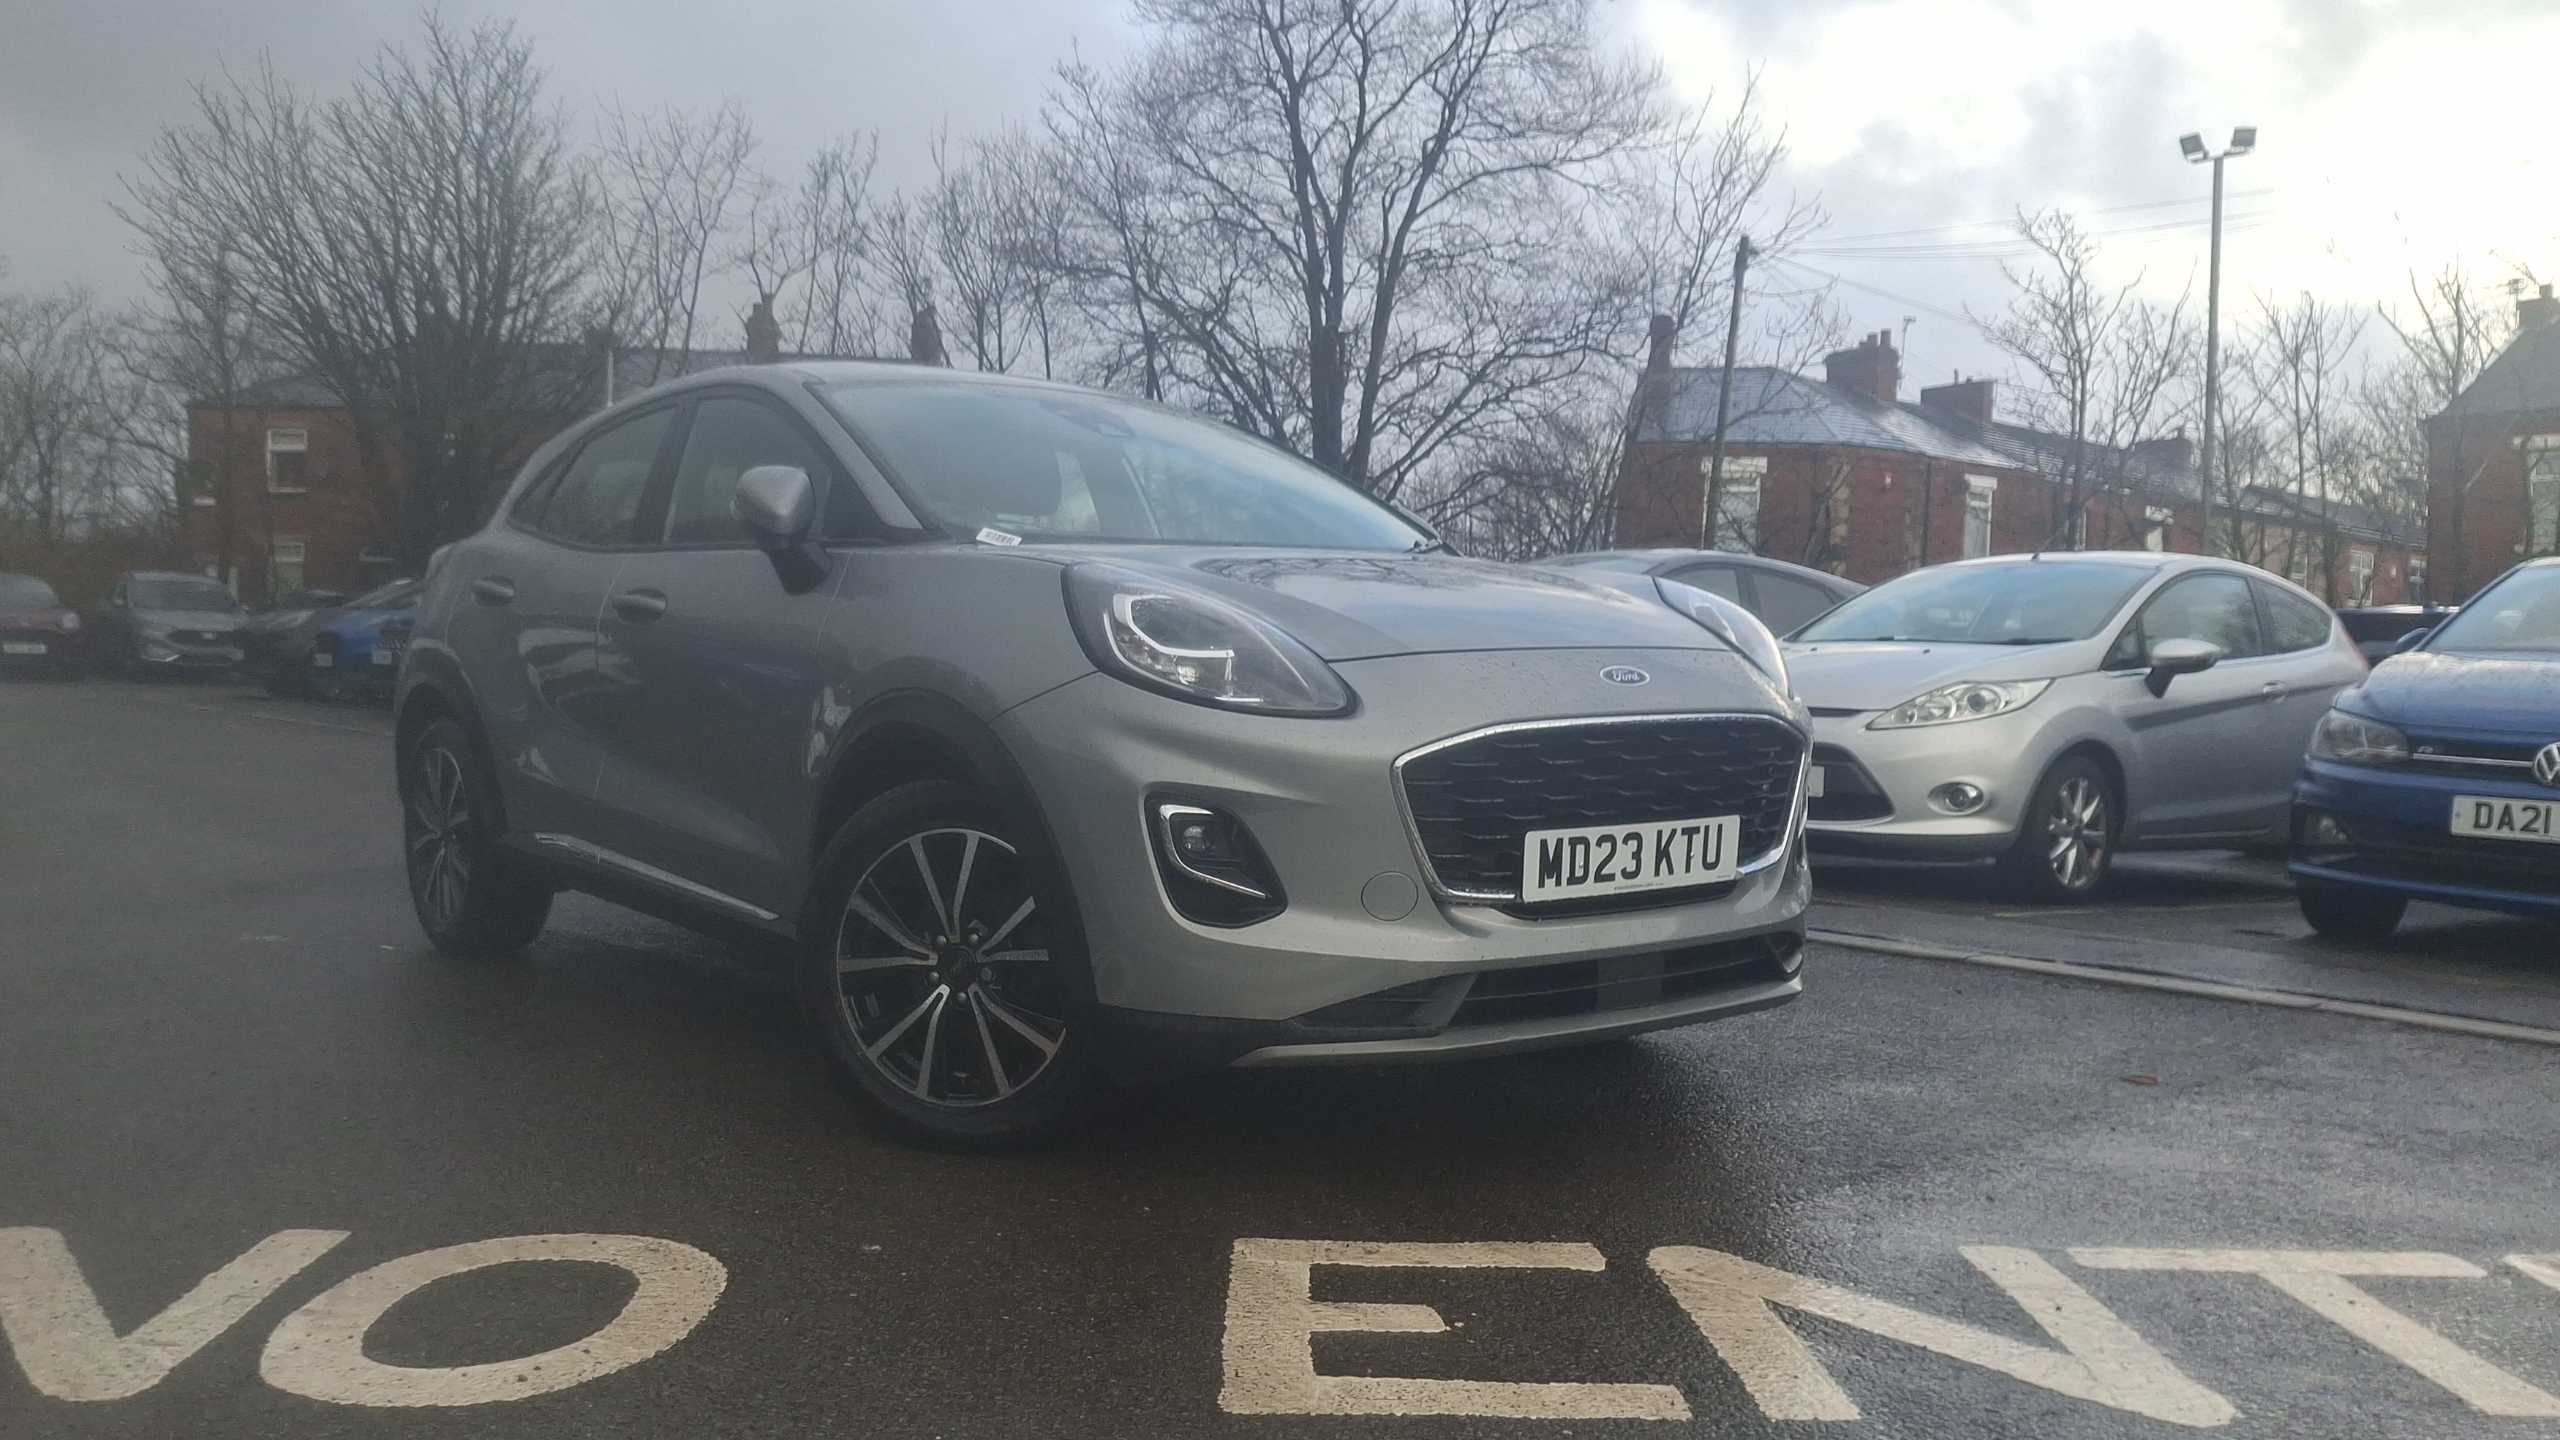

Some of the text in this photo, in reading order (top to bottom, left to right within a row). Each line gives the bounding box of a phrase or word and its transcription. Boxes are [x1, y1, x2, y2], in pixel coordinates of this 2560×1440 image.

[2473, 801, 2552, 834] DA21
[1539, 824, 1723, 888] MD23 KTU
[1217, 1237, 2560, 1427] ENT
